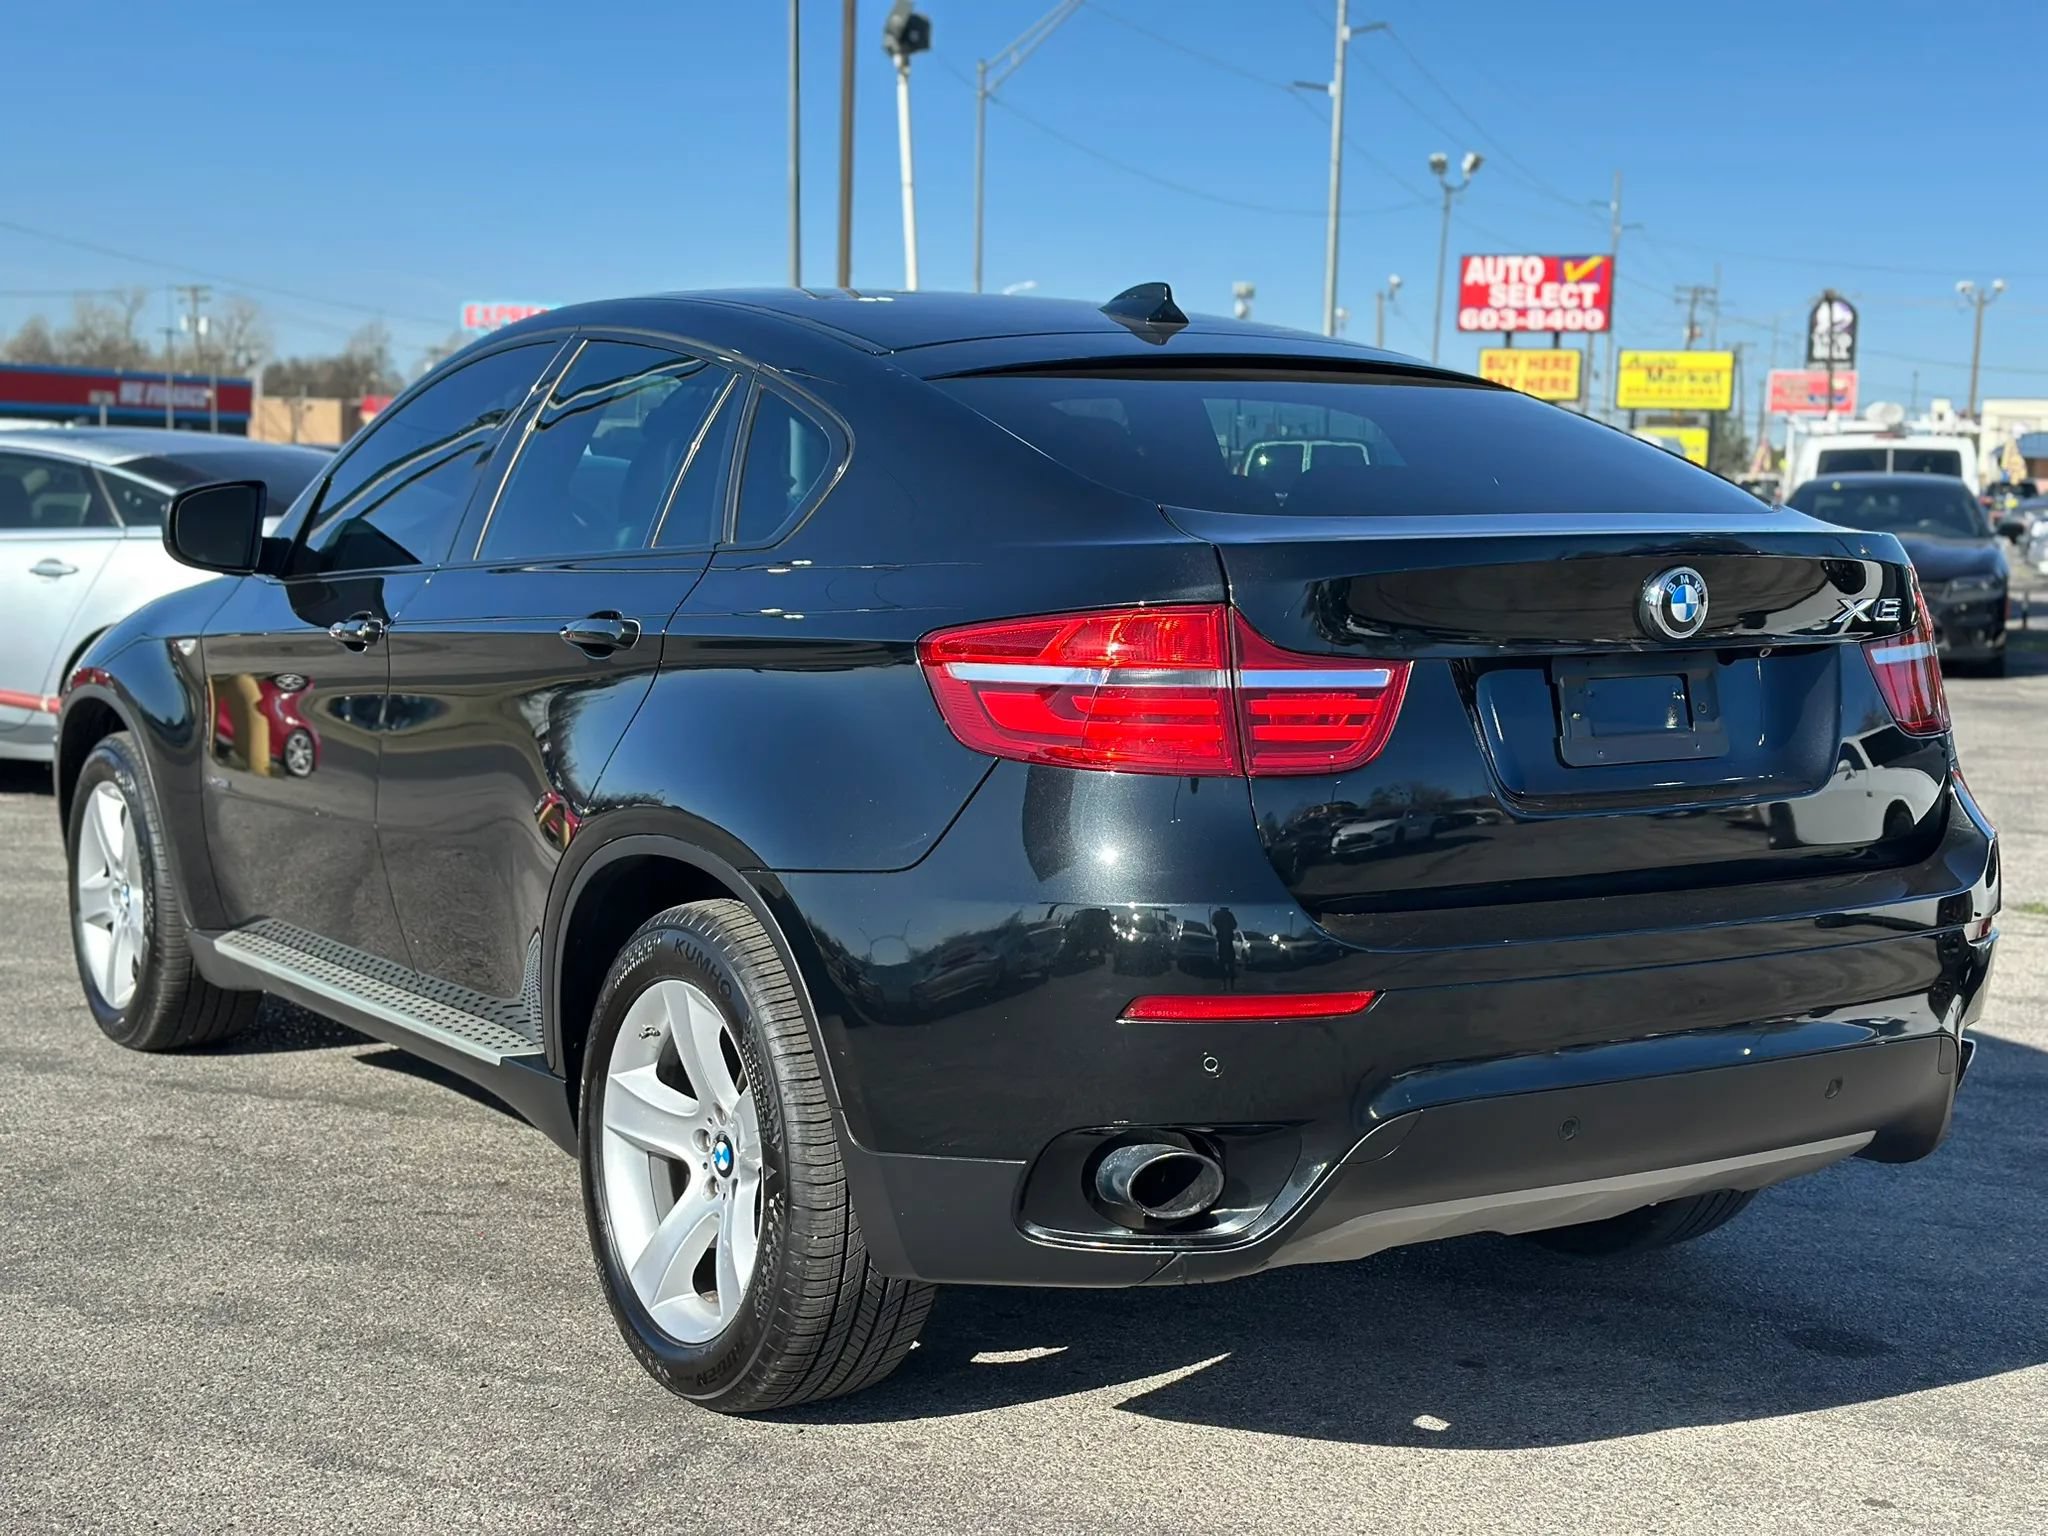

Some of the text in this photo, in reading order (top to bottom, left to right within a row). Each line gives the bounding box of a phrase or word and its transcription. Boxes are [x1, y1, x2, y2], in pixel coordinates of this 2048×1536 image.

[1464, 255, 1545, 285] AUTO
[1488, 282, 1600, 308] SELECT
[1459, 308, 1604, 330] 603-8400
[1487, 356, 1573, 371] BUY HERE
[1524, 376, 1571, 392] HERE
[1666, 574, 1703, 596] BMW
[673, 936, 732, 998] KUMHO
